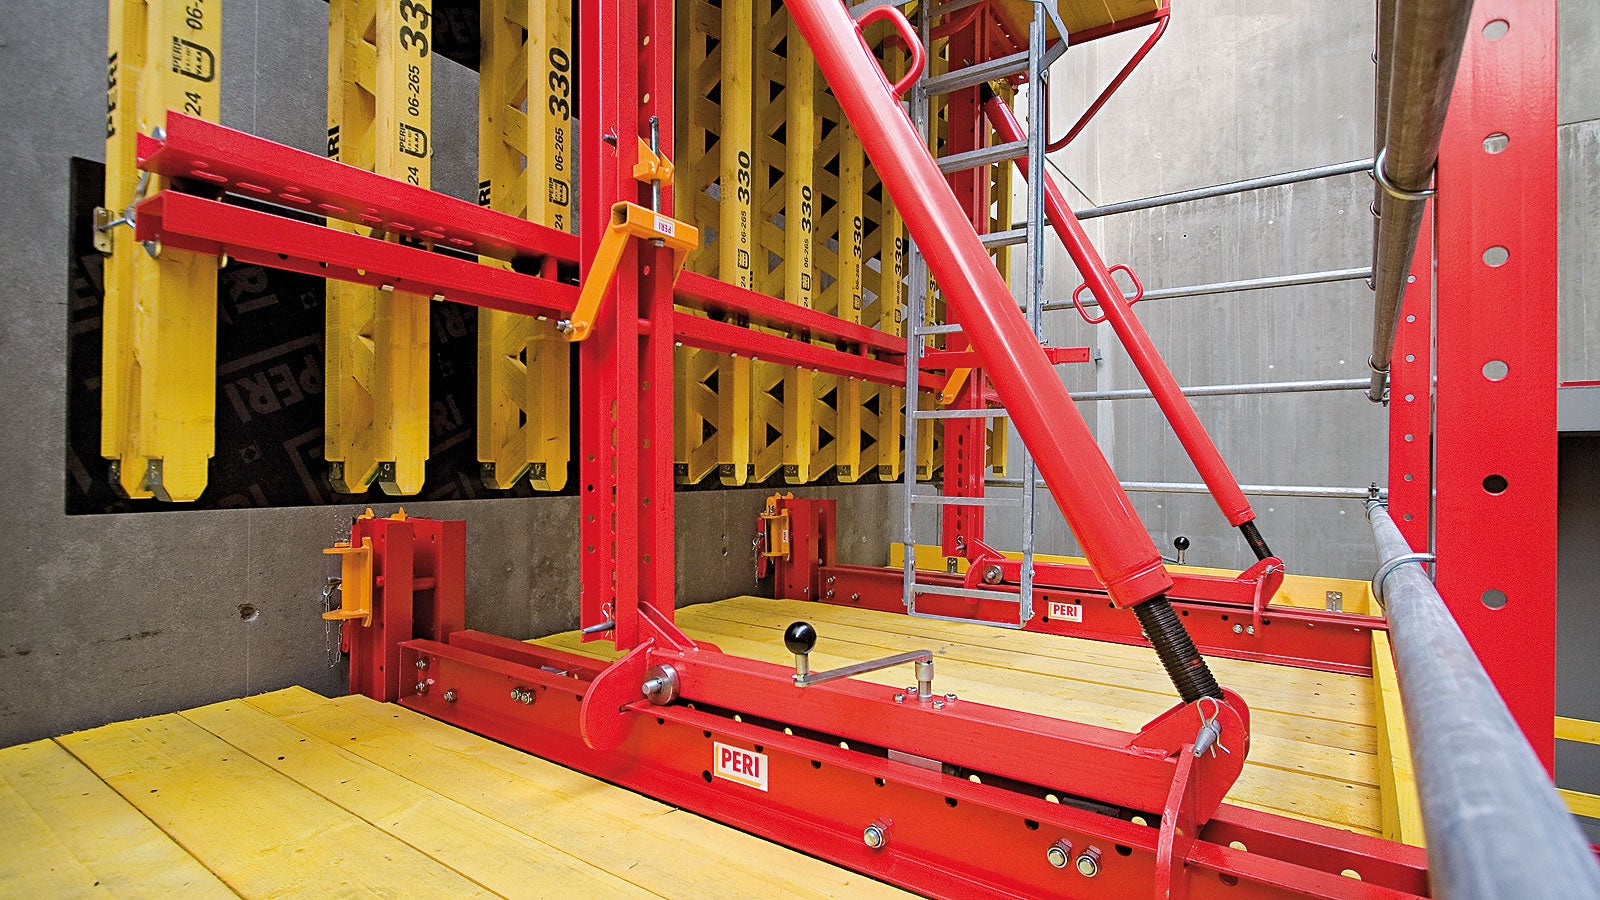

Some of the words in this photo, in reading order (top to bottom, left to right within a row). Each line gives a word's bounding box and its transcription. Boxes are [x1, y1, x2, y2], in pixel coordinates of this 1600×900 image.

[408, 64, 420, 117] 06-265
[548, 47, 571, 121] 330
[554, 127, 564, 171] 06-265
[407, 166, 419, 186] 24
[737, 150, 750, 206] 330
[554, 213, 564, 230] 24
[658, 221, 672, 234] PERI
[801, 185, 812, 234] 330
[853, 216, 862, 260] 330
[894, 237, 902, 277] 330
[223, 354, 323, 425] PERI
[1053, 604, 1077, 617] PERI
[721, 747, 760, 779] PERI
